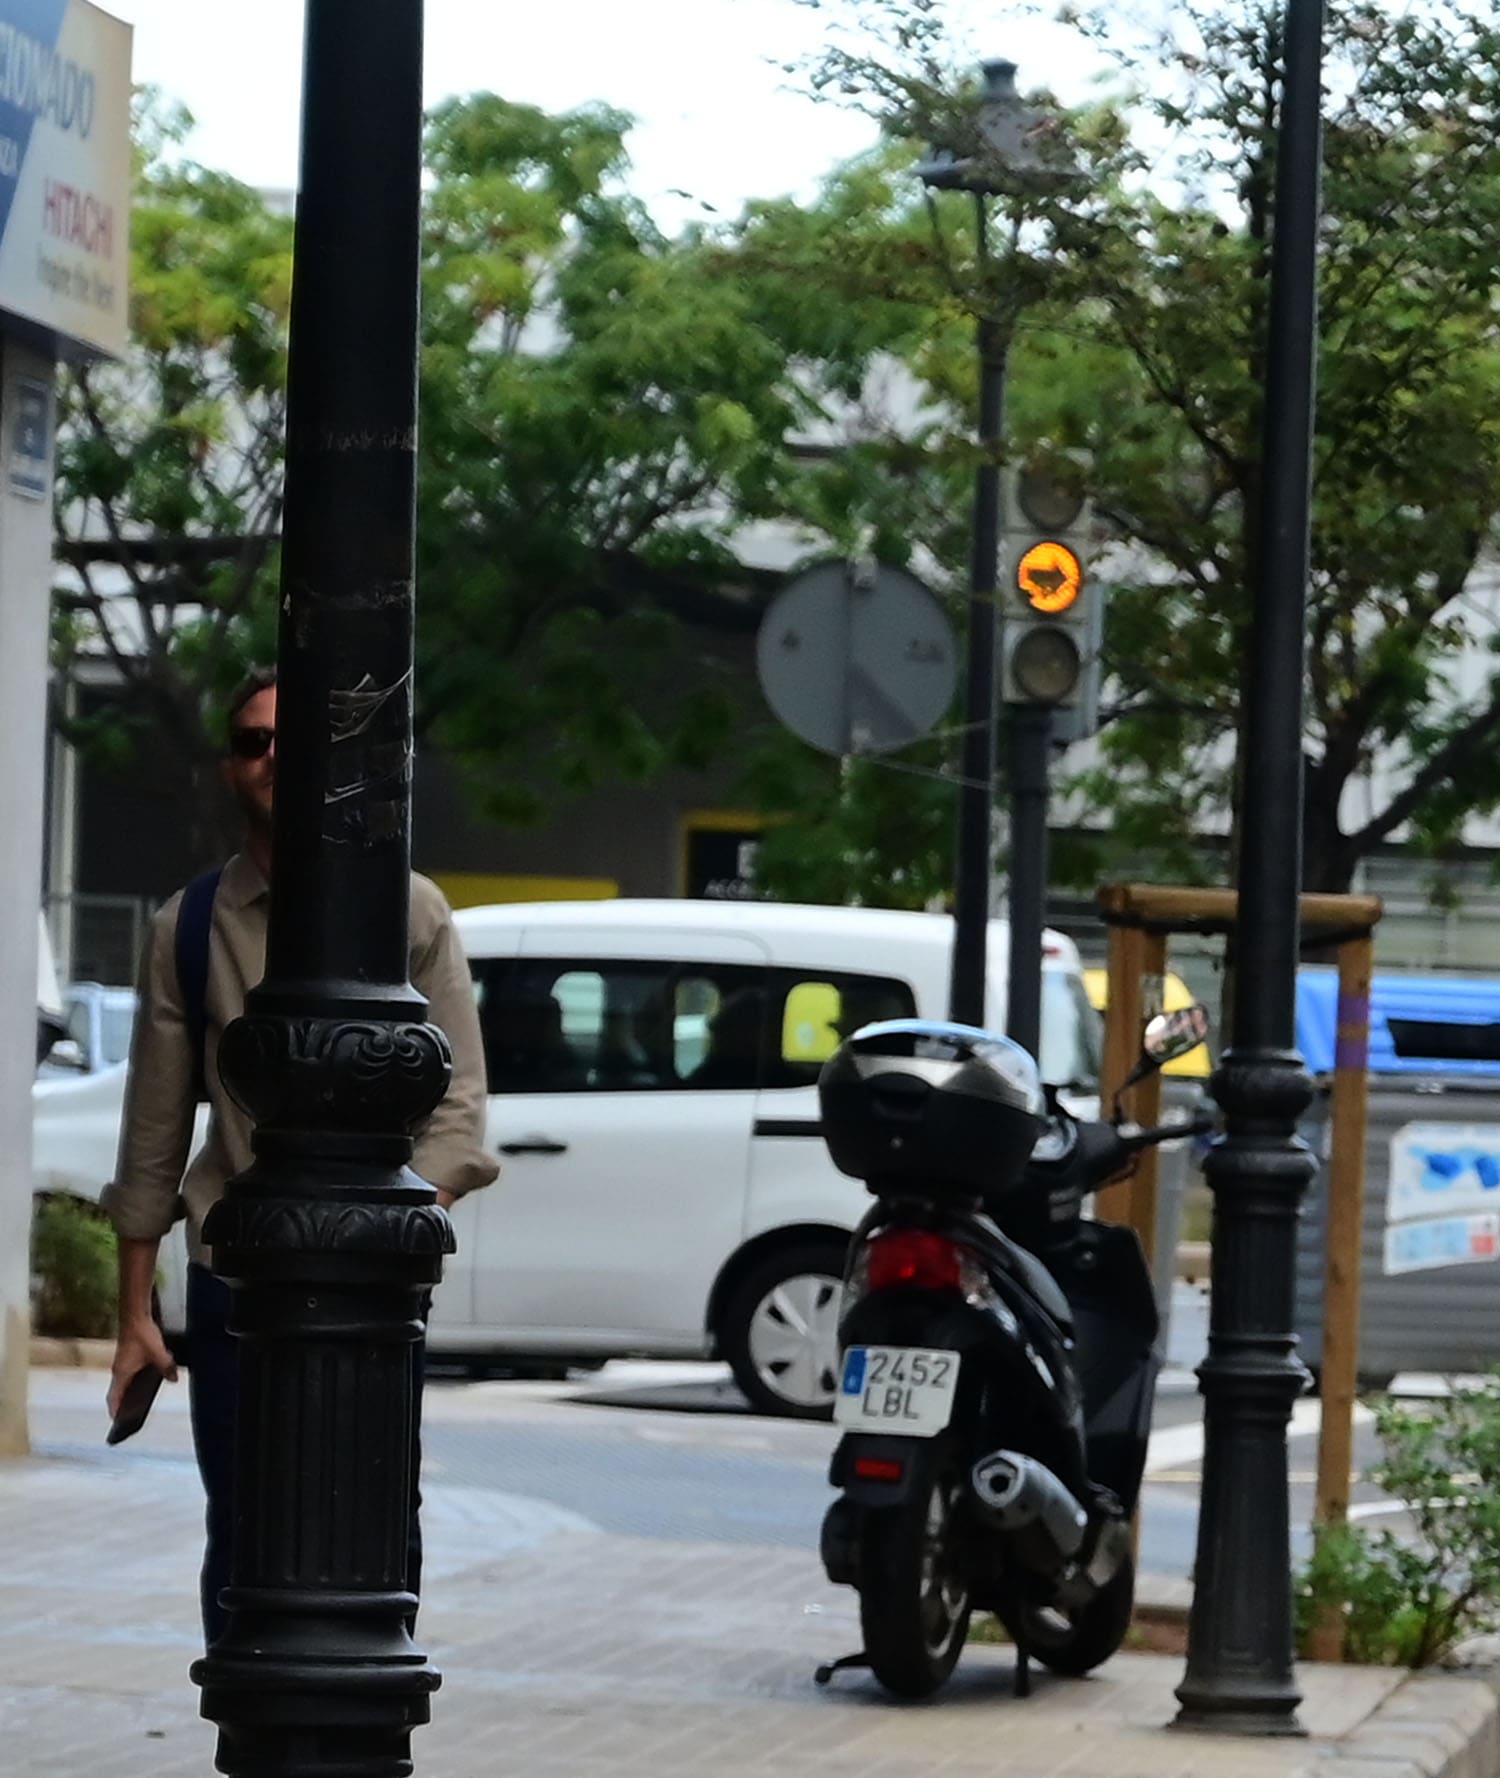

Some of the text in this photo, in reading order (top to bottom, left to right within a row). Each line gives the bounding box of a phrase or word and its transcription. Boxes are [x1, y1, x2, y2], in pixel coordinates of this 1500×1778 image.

[43, 177, 114, 260] HITACHI
[869, 1351, 950, 1388] 2452
[862, 1386, 920, 1420] LBL
